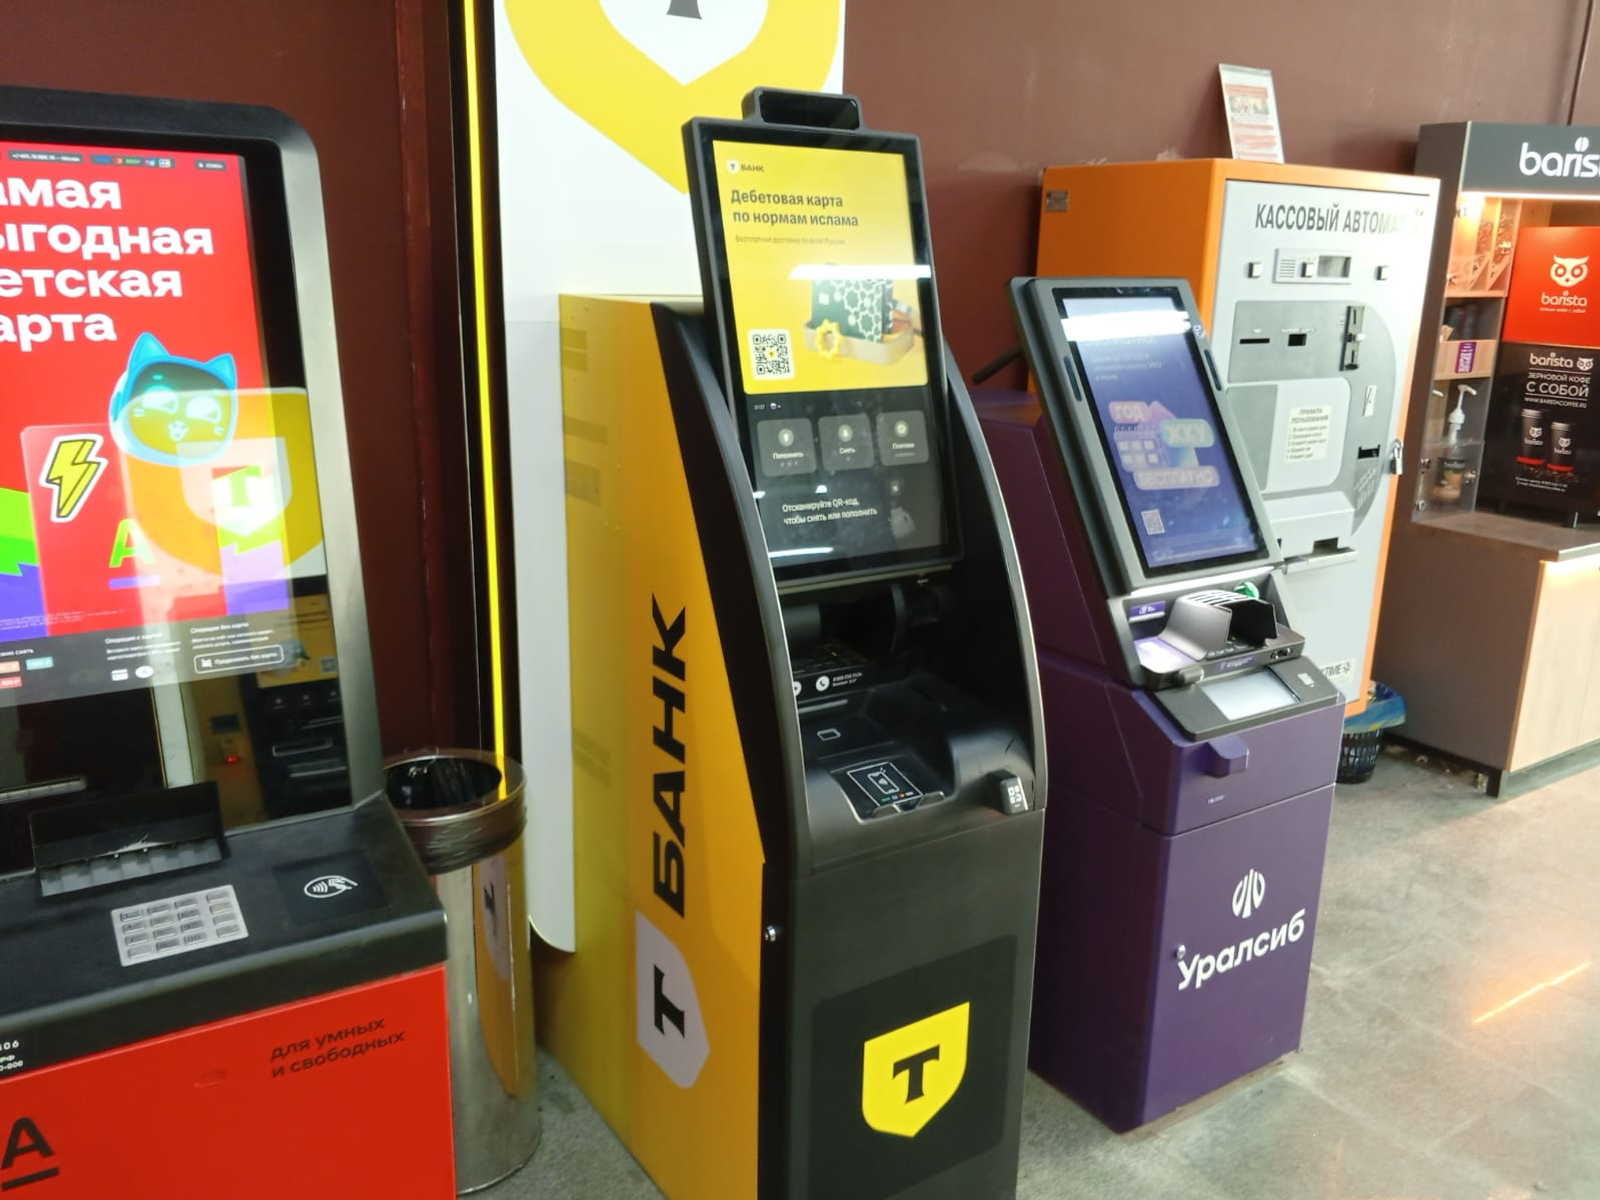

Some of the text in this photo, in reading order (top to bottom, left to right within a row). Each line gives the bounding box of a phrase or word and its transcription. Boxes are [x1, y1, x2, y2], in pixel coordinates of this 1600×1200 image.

[1519, 136, 1600, 178] baris
[741, 164, 765, 172] БАНК
[0, 177, 122, 210] мая
[731, 189, 843, 209] Дебетовая карта
[733, 211, 859, 226] по нормам ислама
[1255, 203, 1340, 232] КАССОВЫЙ
[0, 267, 183, 298] етская
[1541, 290, 1587, 306] barista
[1529, 352, 1574, 368] barista
[1528, 371, 1591, 384] ЗЕРНОВОЙ КОФЕ
[1526, 381, 1589, 397] С СОБОЙ
[784, 514, 806, 525] чтобы
[1321, 664, 1343, 676] TIME
[652, 593, 686, 918] БАНК
[1178, 908, 1306, 991] Уралсиб
[270, 1018, 386, 1062] для умных
[272, 1030, 406, 1079] и свободных
